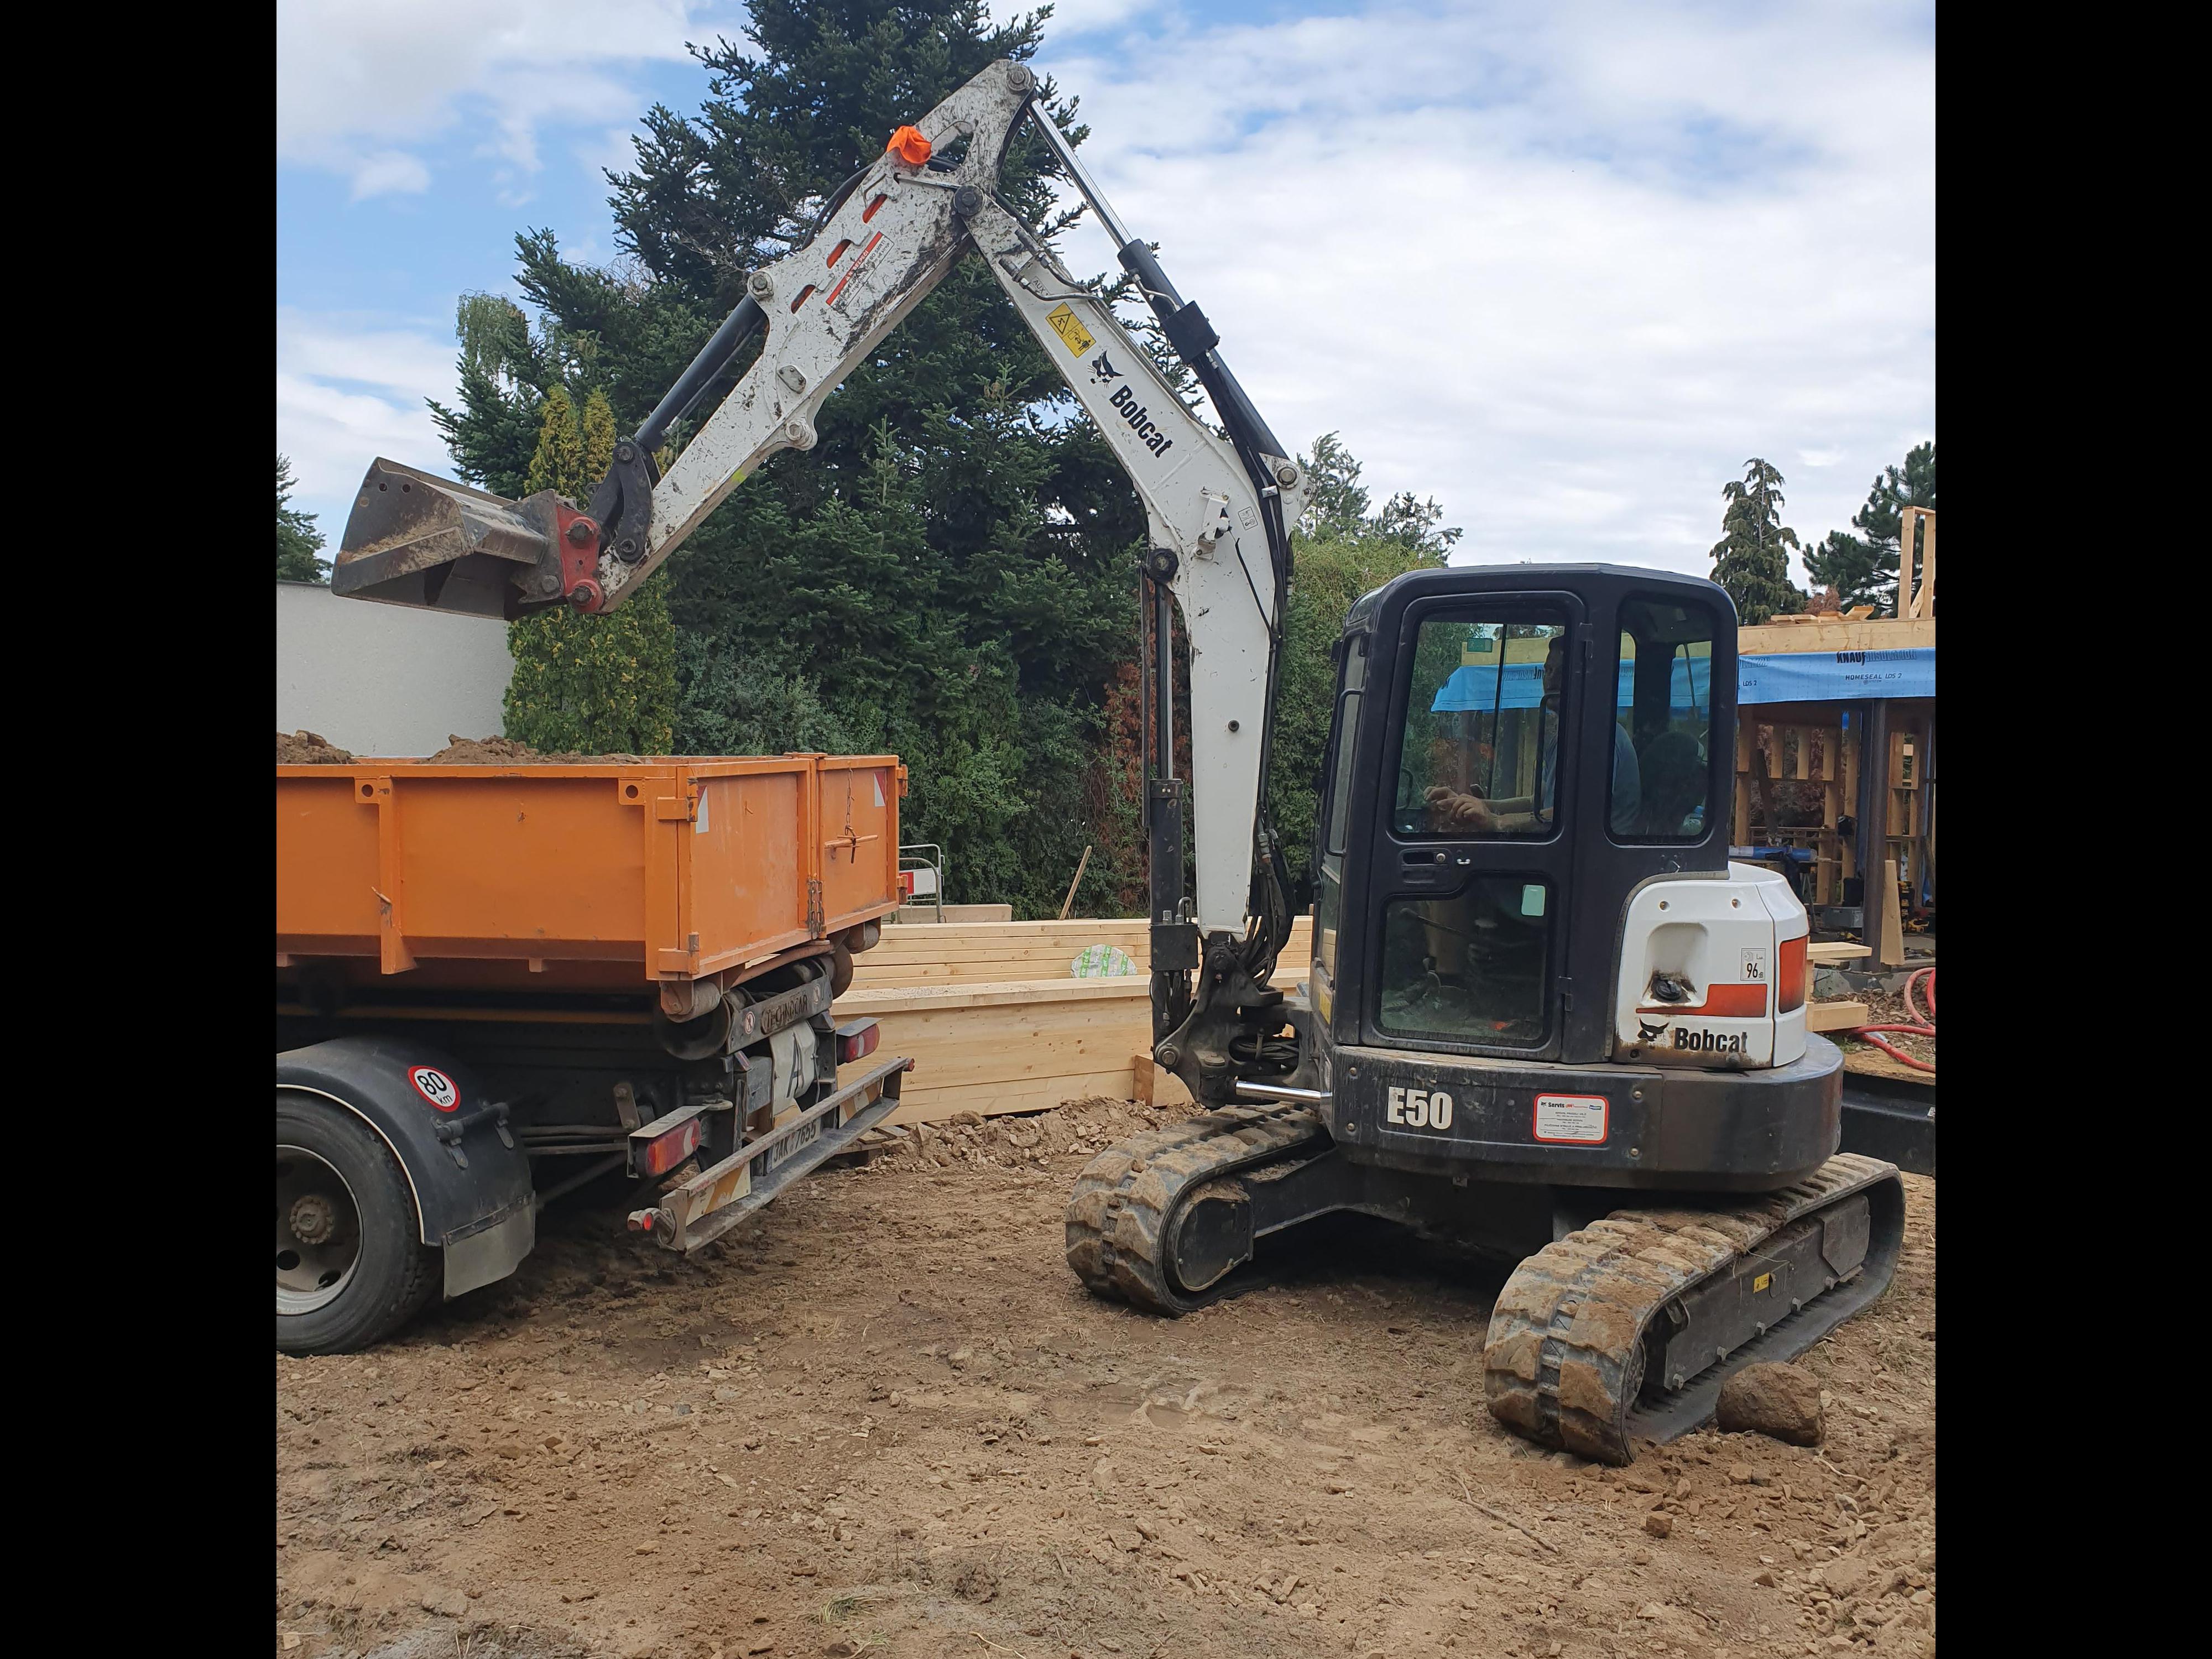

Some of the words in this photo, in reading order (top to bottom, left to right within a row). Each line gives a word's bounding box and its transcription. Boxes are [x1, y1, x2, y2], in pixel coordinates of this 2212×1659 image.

[1032, 279, 1046, 293] AUX
[1109, 384, 1173, 458] Bobcat
[1837, 651, 1866, 666] KNAUF
[1746, 963, 1758, 978] 96
[1674, 1027, 1747, 1053] Bobcat
[417, 1072, 447, 1095] 80
[436, 1095, 453, 1104] km
[1386, 1086, 1453, 1129] E50
